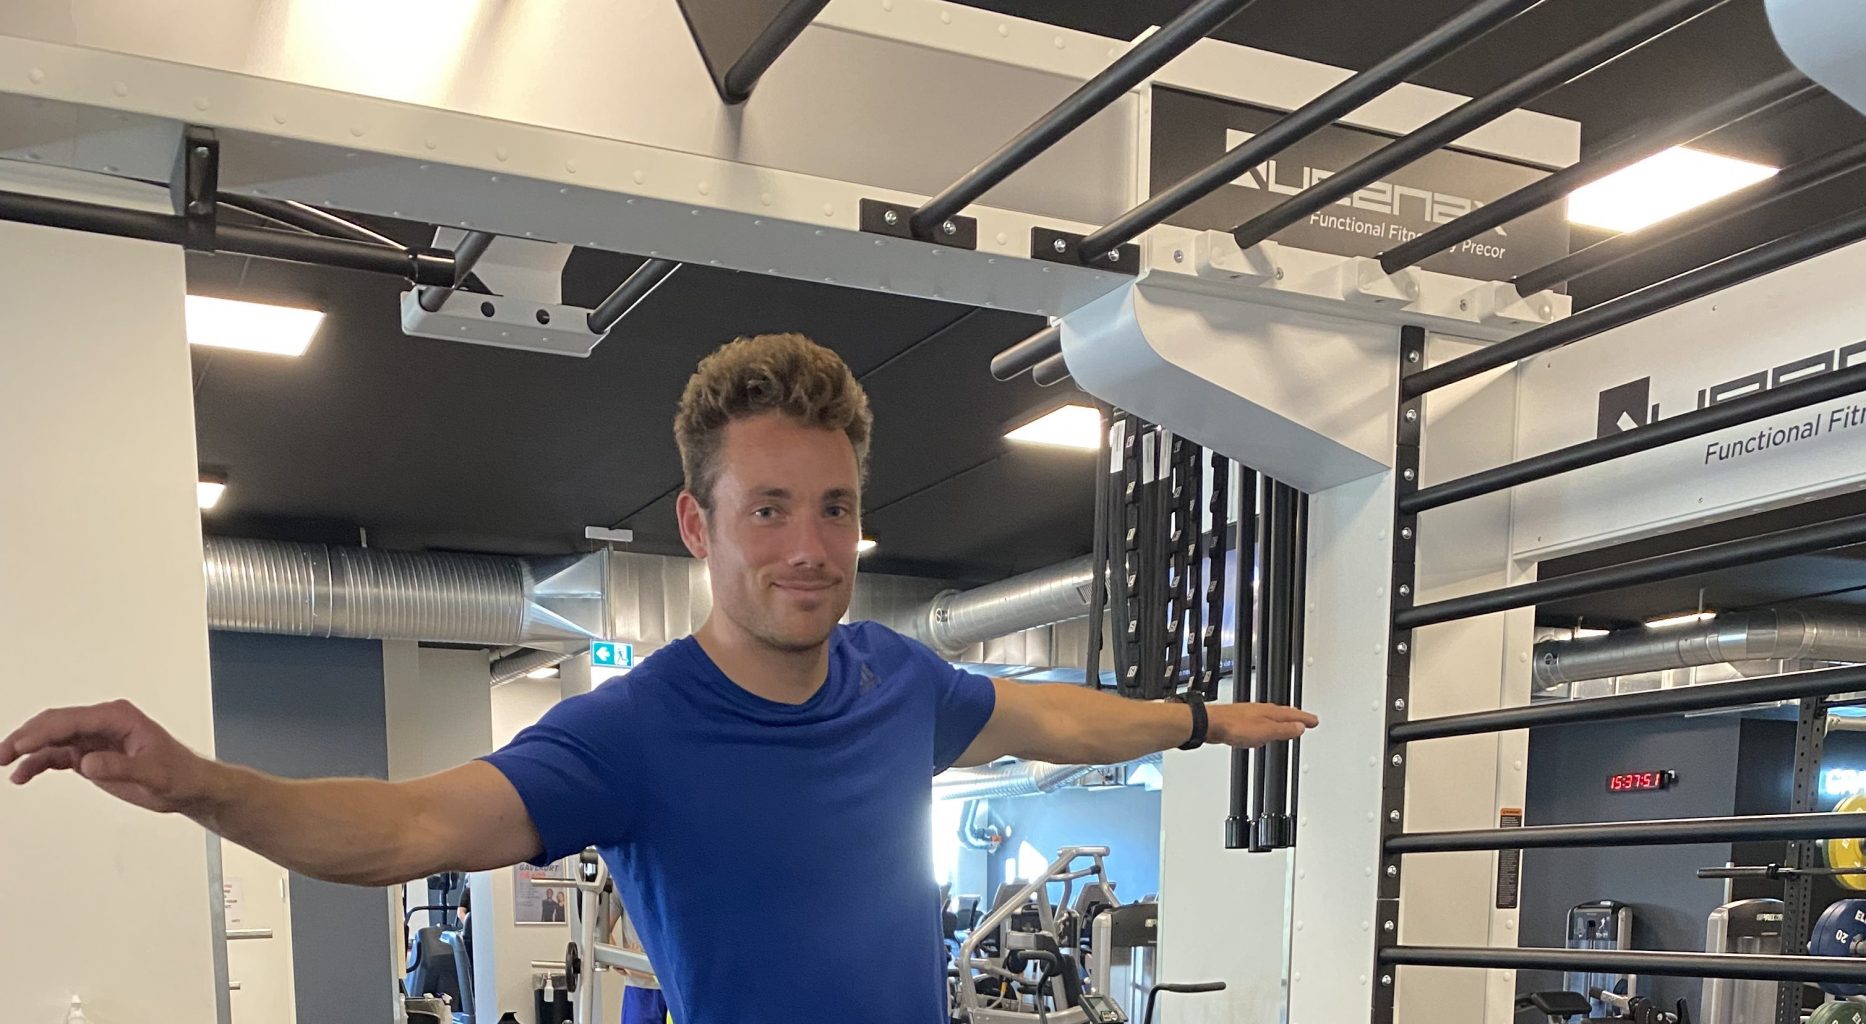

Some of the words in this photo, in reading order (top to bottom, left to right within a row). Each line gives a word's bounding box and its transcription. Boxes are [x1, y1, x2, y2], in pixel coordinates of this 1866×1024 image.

[1310, 211, 1386, 238] Functional
[1462, 239, 1506, 259] Precor
[1705, 413, 1821, 465] Functional
[1835, 929, 1849, 944] 20
